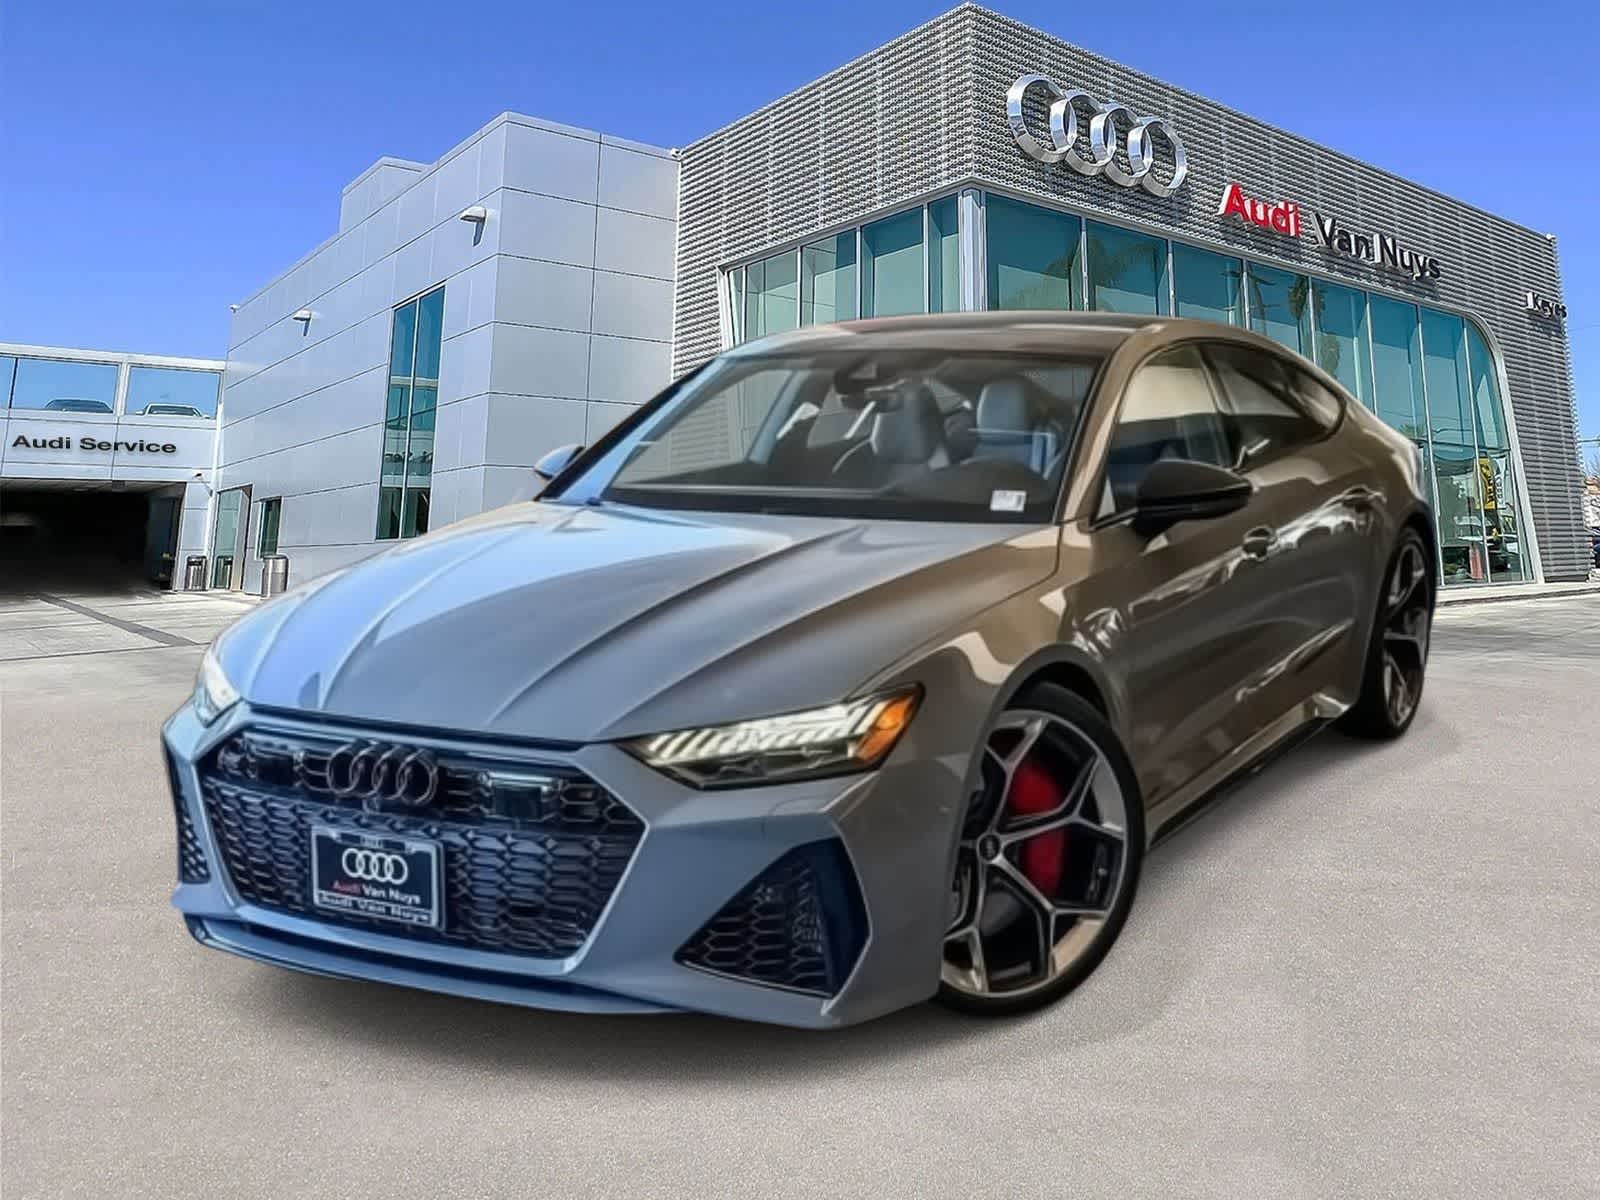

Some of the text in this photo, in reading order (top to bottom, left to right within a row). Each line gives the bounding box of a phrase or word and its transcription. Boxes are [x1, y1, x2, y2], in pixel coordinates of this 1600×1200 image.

[1219, 182, 1441, 281] Audi Van Nuys
[12, 435, 177, 453] Audi Service
[331, 880, 421, 905] Audi Van Nuys
